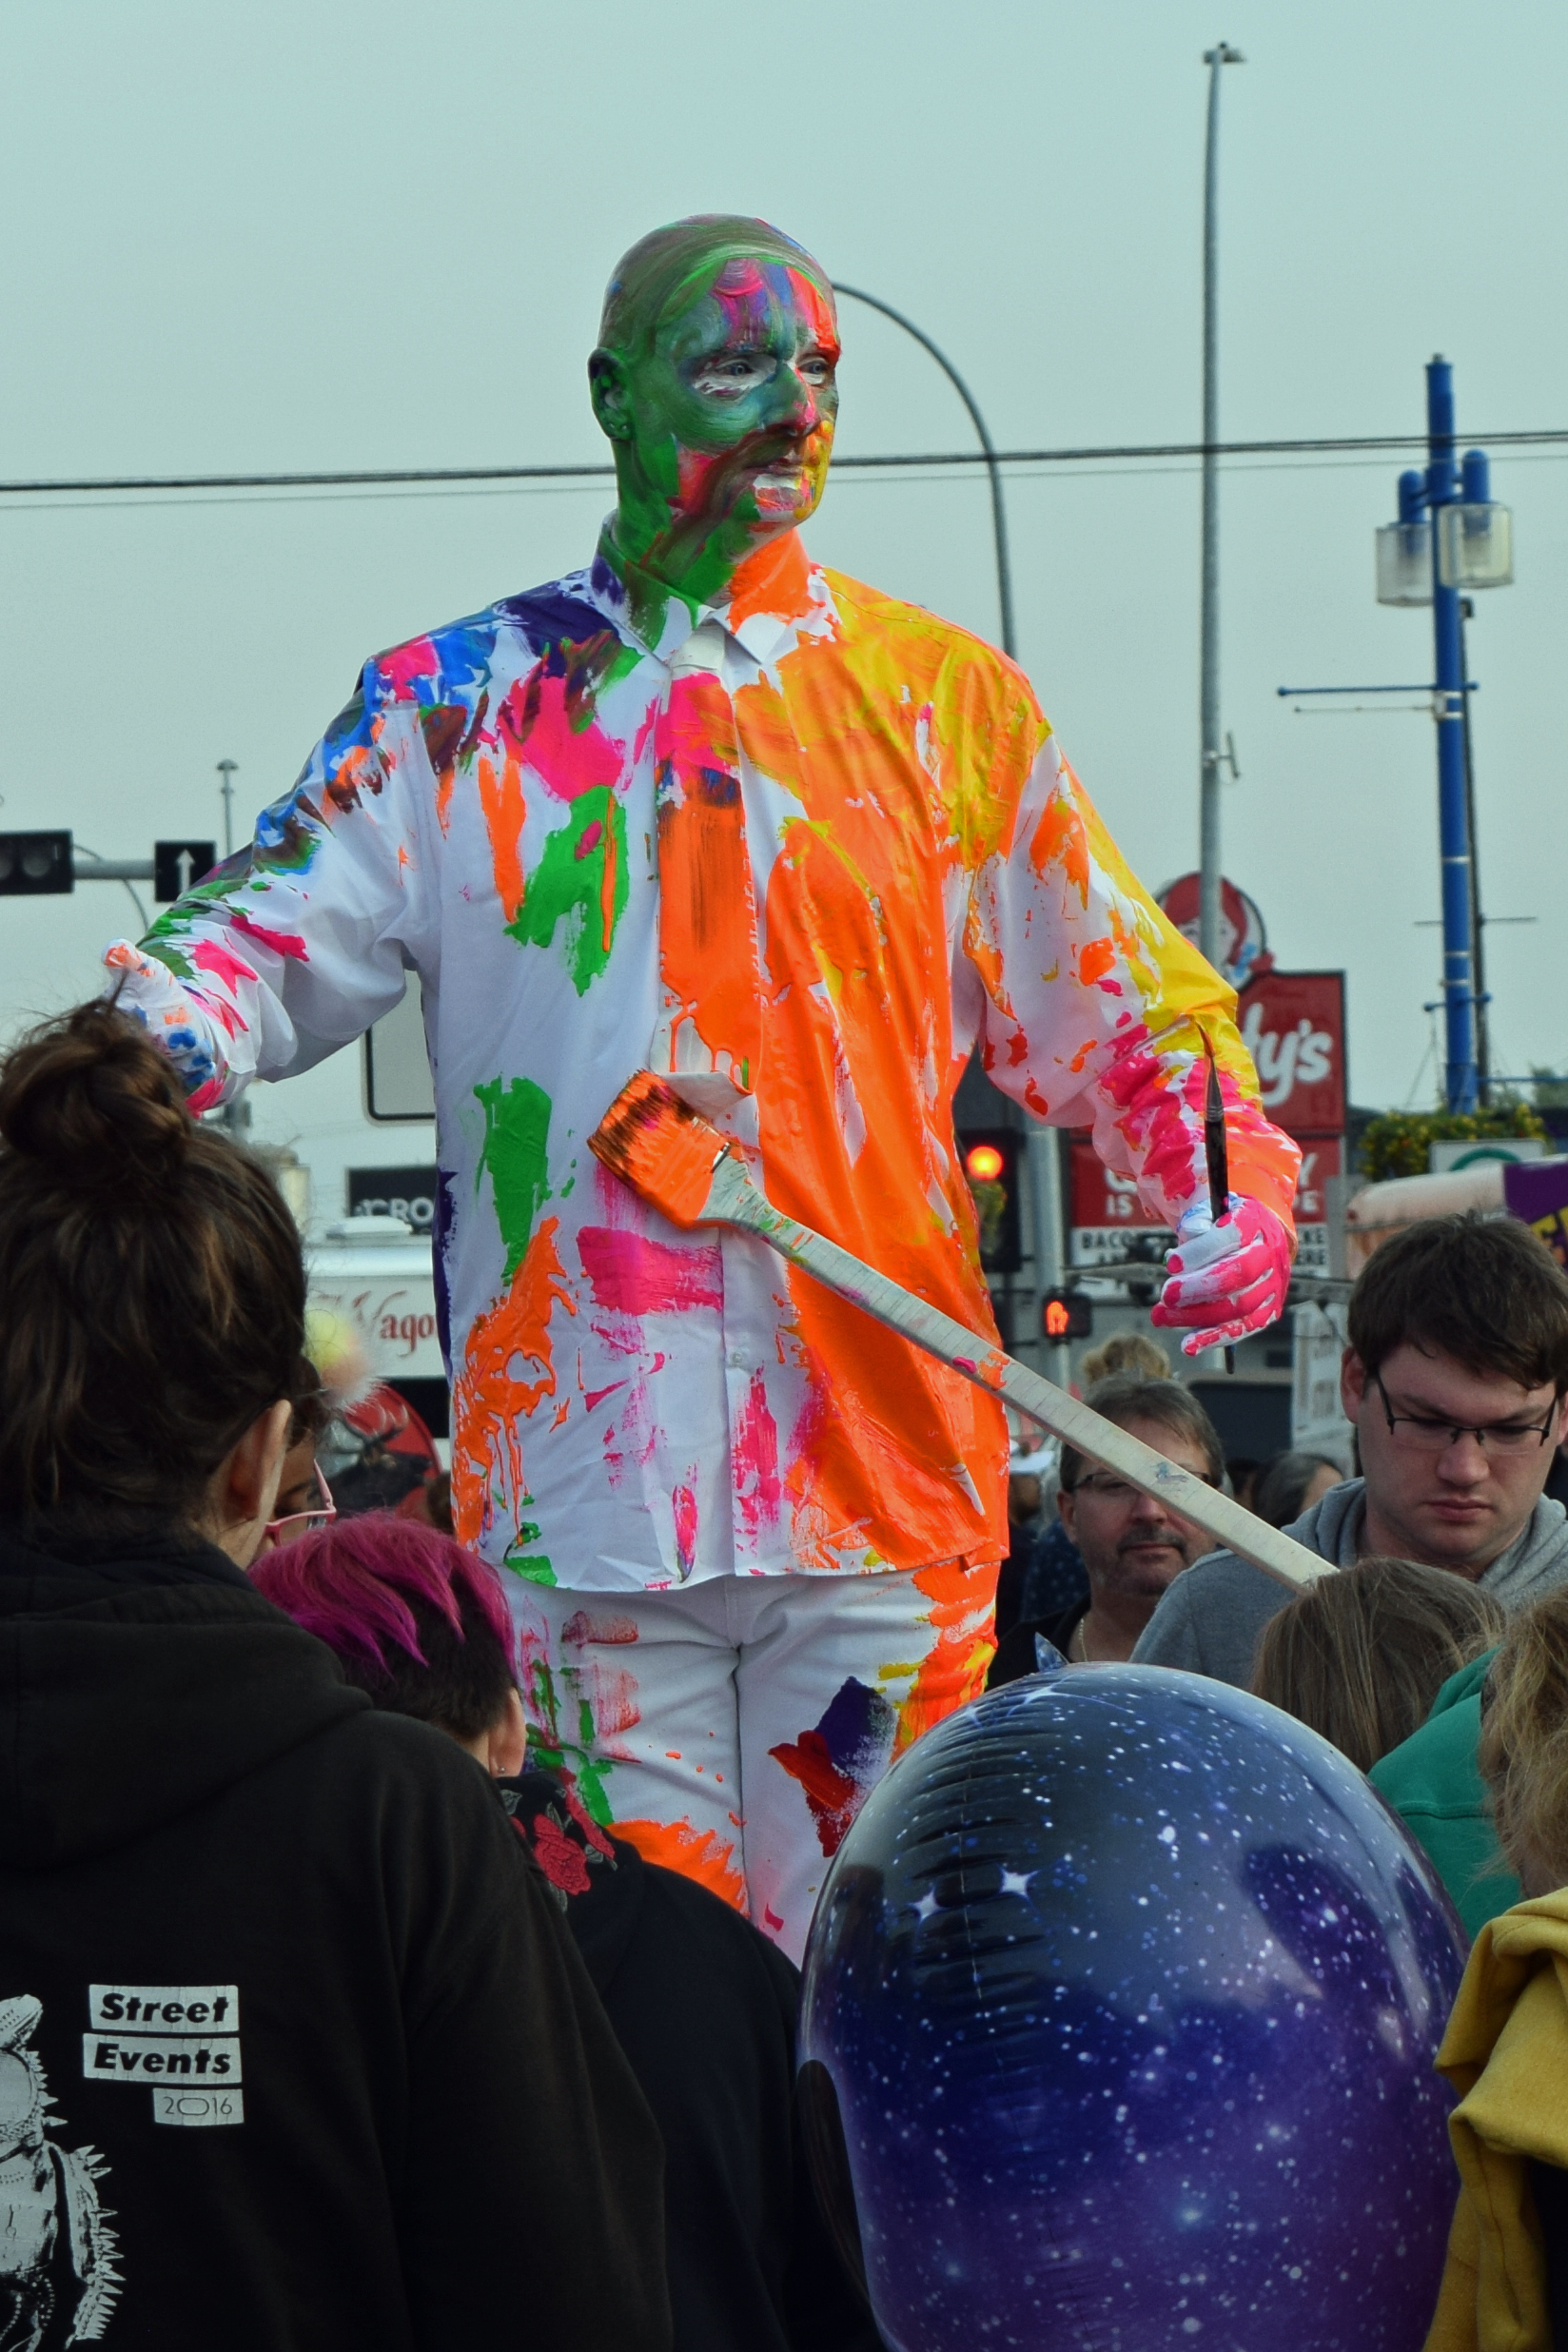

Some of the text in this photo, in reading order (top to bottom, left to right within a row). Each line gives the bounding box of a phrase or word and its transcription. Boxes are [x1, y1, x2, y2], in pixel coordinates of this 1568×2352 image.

[1106, 1194, 1133, 1217] IS
[100, 1992, 229, 2024] Street
[94, 2043, 231, 2074] Events
[164, 2096, 232, 2116] 2016
